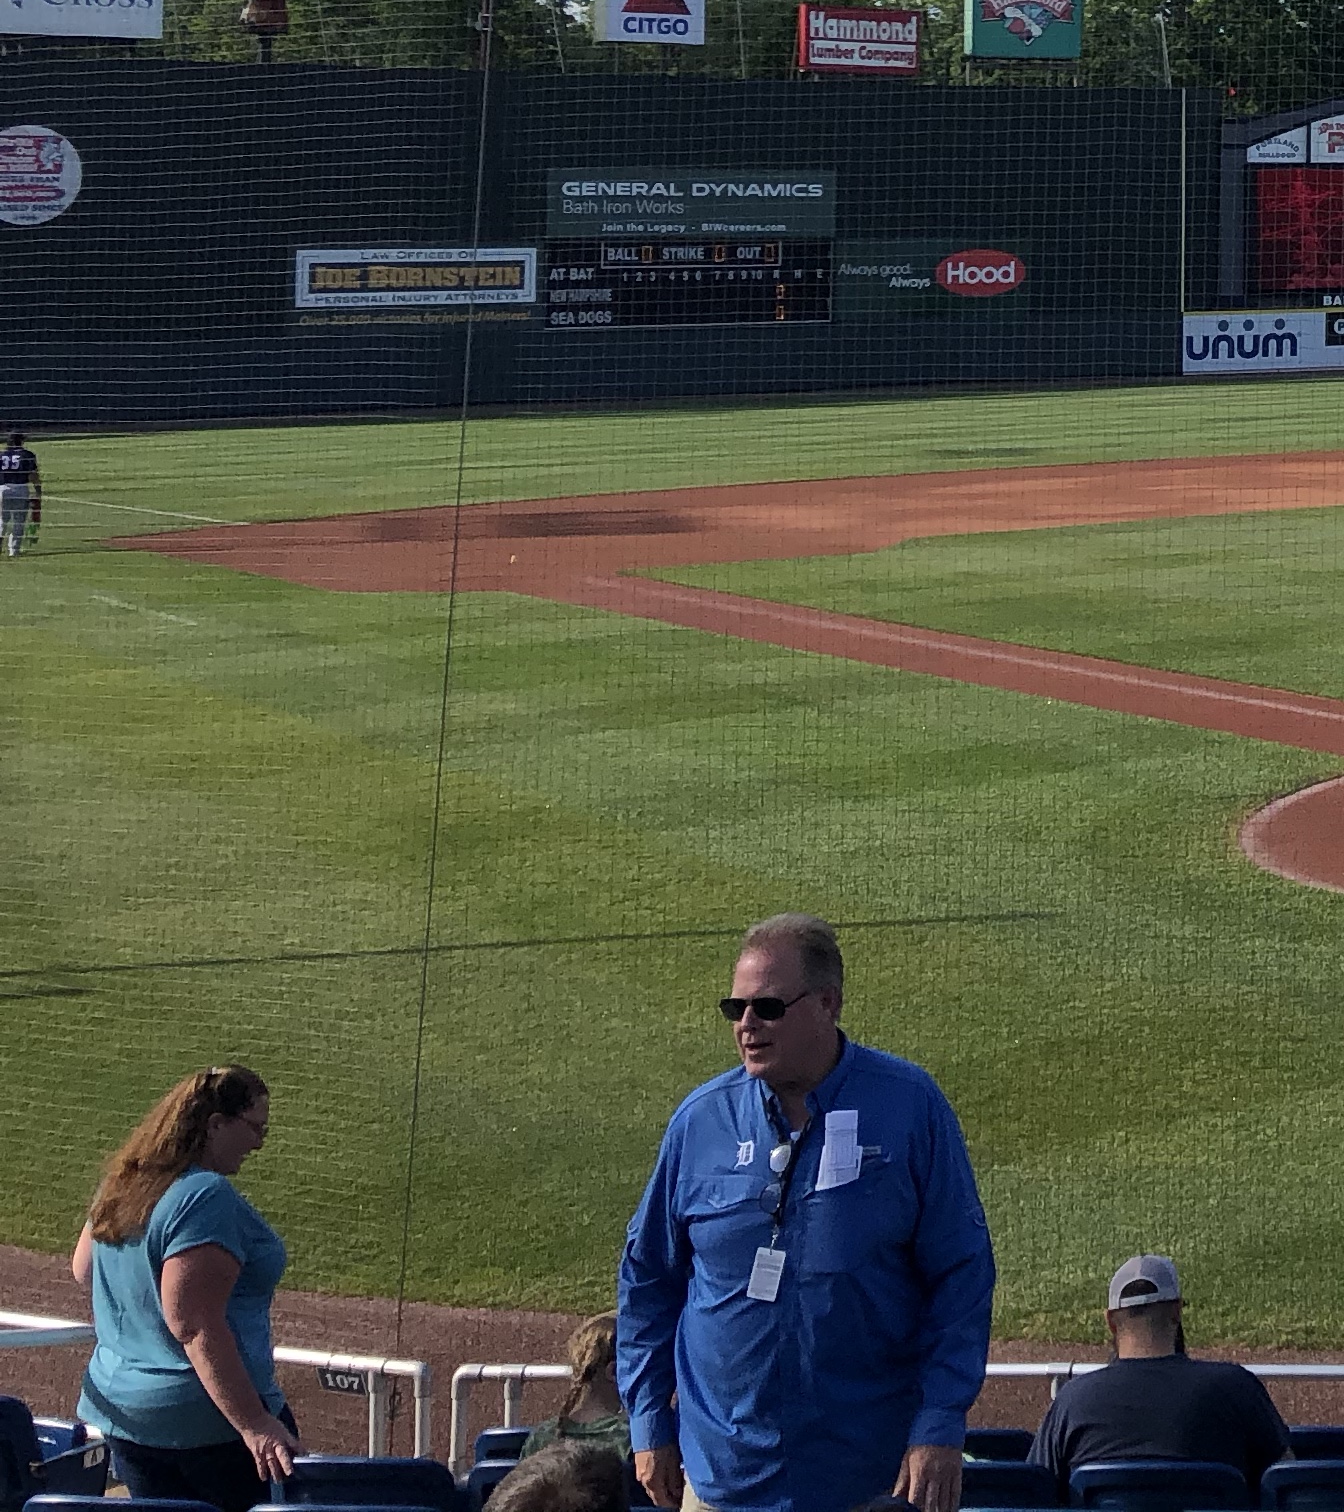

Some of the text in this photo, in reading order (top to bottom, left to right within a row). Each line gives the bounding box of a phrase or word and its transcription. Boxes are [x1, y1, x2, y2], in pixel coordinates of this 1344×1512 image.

[623, 17, 689, 35] CITGO
[809, 11, 917, 42] Hammond
[811, 43, 916, 65] Lumber Company
[562, 182, 823, 197] GENERAL DYNAMICS
[562, 200, 685, 214] Bath Iron Works
[602, 223, 623, 232] Join
[627, 223, 644, 231] the
[647, 223, 686, 233] Legacy
[360, 251, 389, 260] LAW
[396, 251, 454, 260] OFFICES
[607, 247, 761, 260] BALL STRIKE OUT
[314, 266, 521, 288] JOE BORNSTEIN
[550, 268, 594, 280] AT BAT
[838, 263, 878, 276] Always
[946, 261, 1016, 285] Hood
[889, 277, 930, 289] Always
[315, 295, 386, 304] PERSONAL
[392, 294, 439, 303] INJURY
[551, 311, 612, 324] SEA DOGS
[1186, 319, 1298, 361] unum
[1, 455, 20, 470] 35
[734, 1140, 755, 1170] D
[325, 1373, 360, 1390] 107
